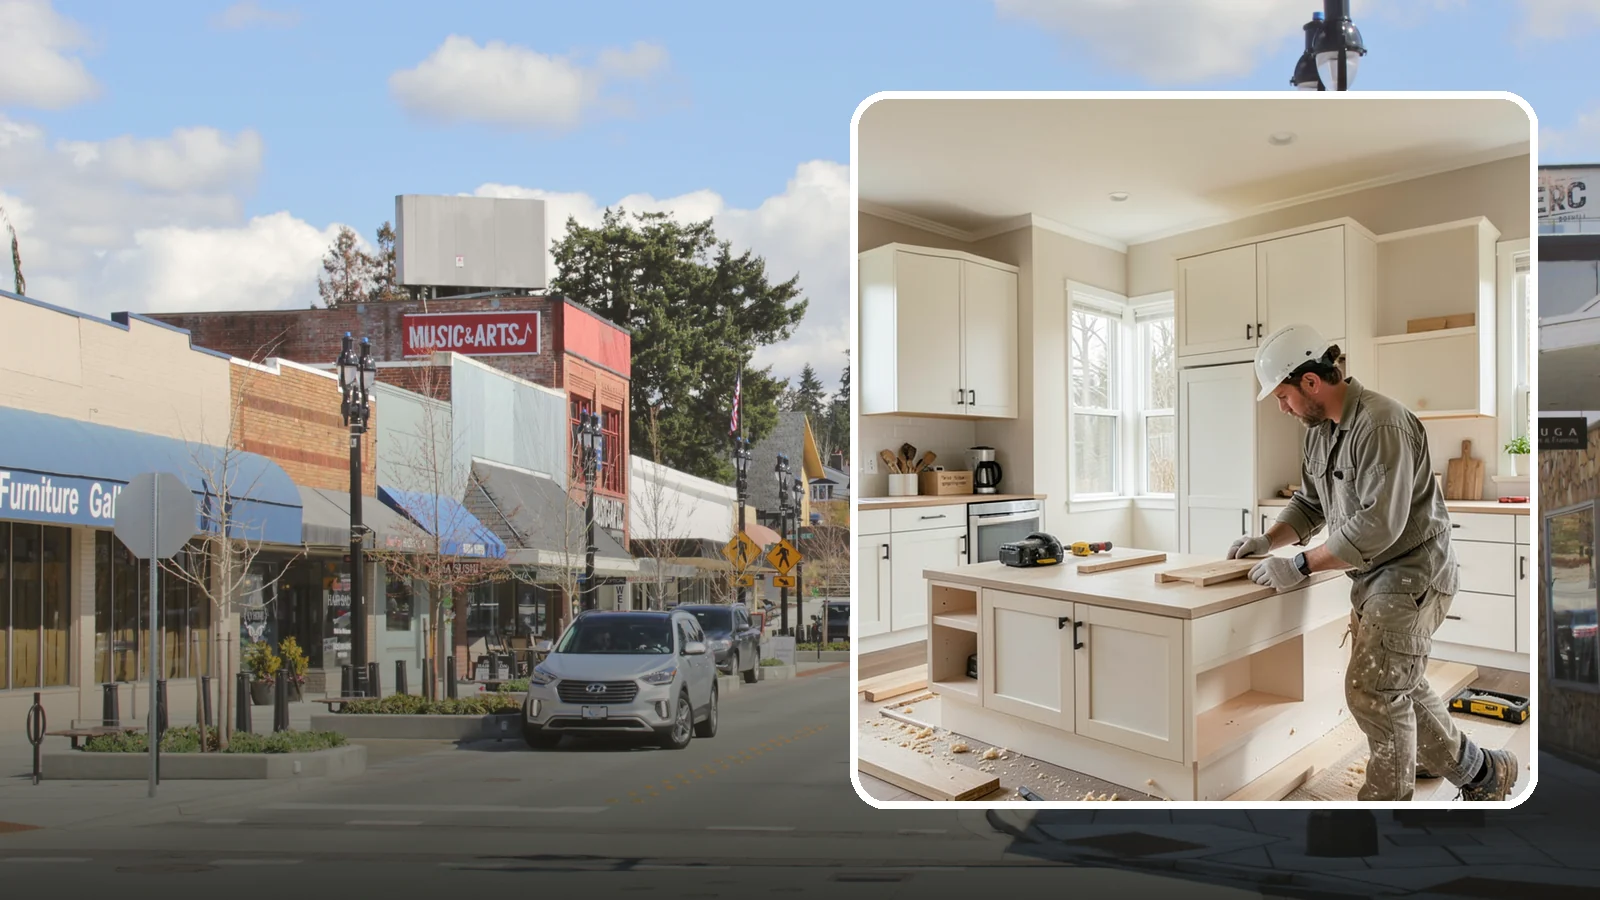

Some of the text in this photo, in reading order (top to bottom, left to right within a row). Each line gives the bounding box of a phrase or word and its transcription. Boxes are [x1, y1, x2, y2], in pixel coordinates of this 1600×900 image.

[408, 322, 520, 349] MUSIC&ARTS
[0, 471, 122, 519] Furniture Gal
